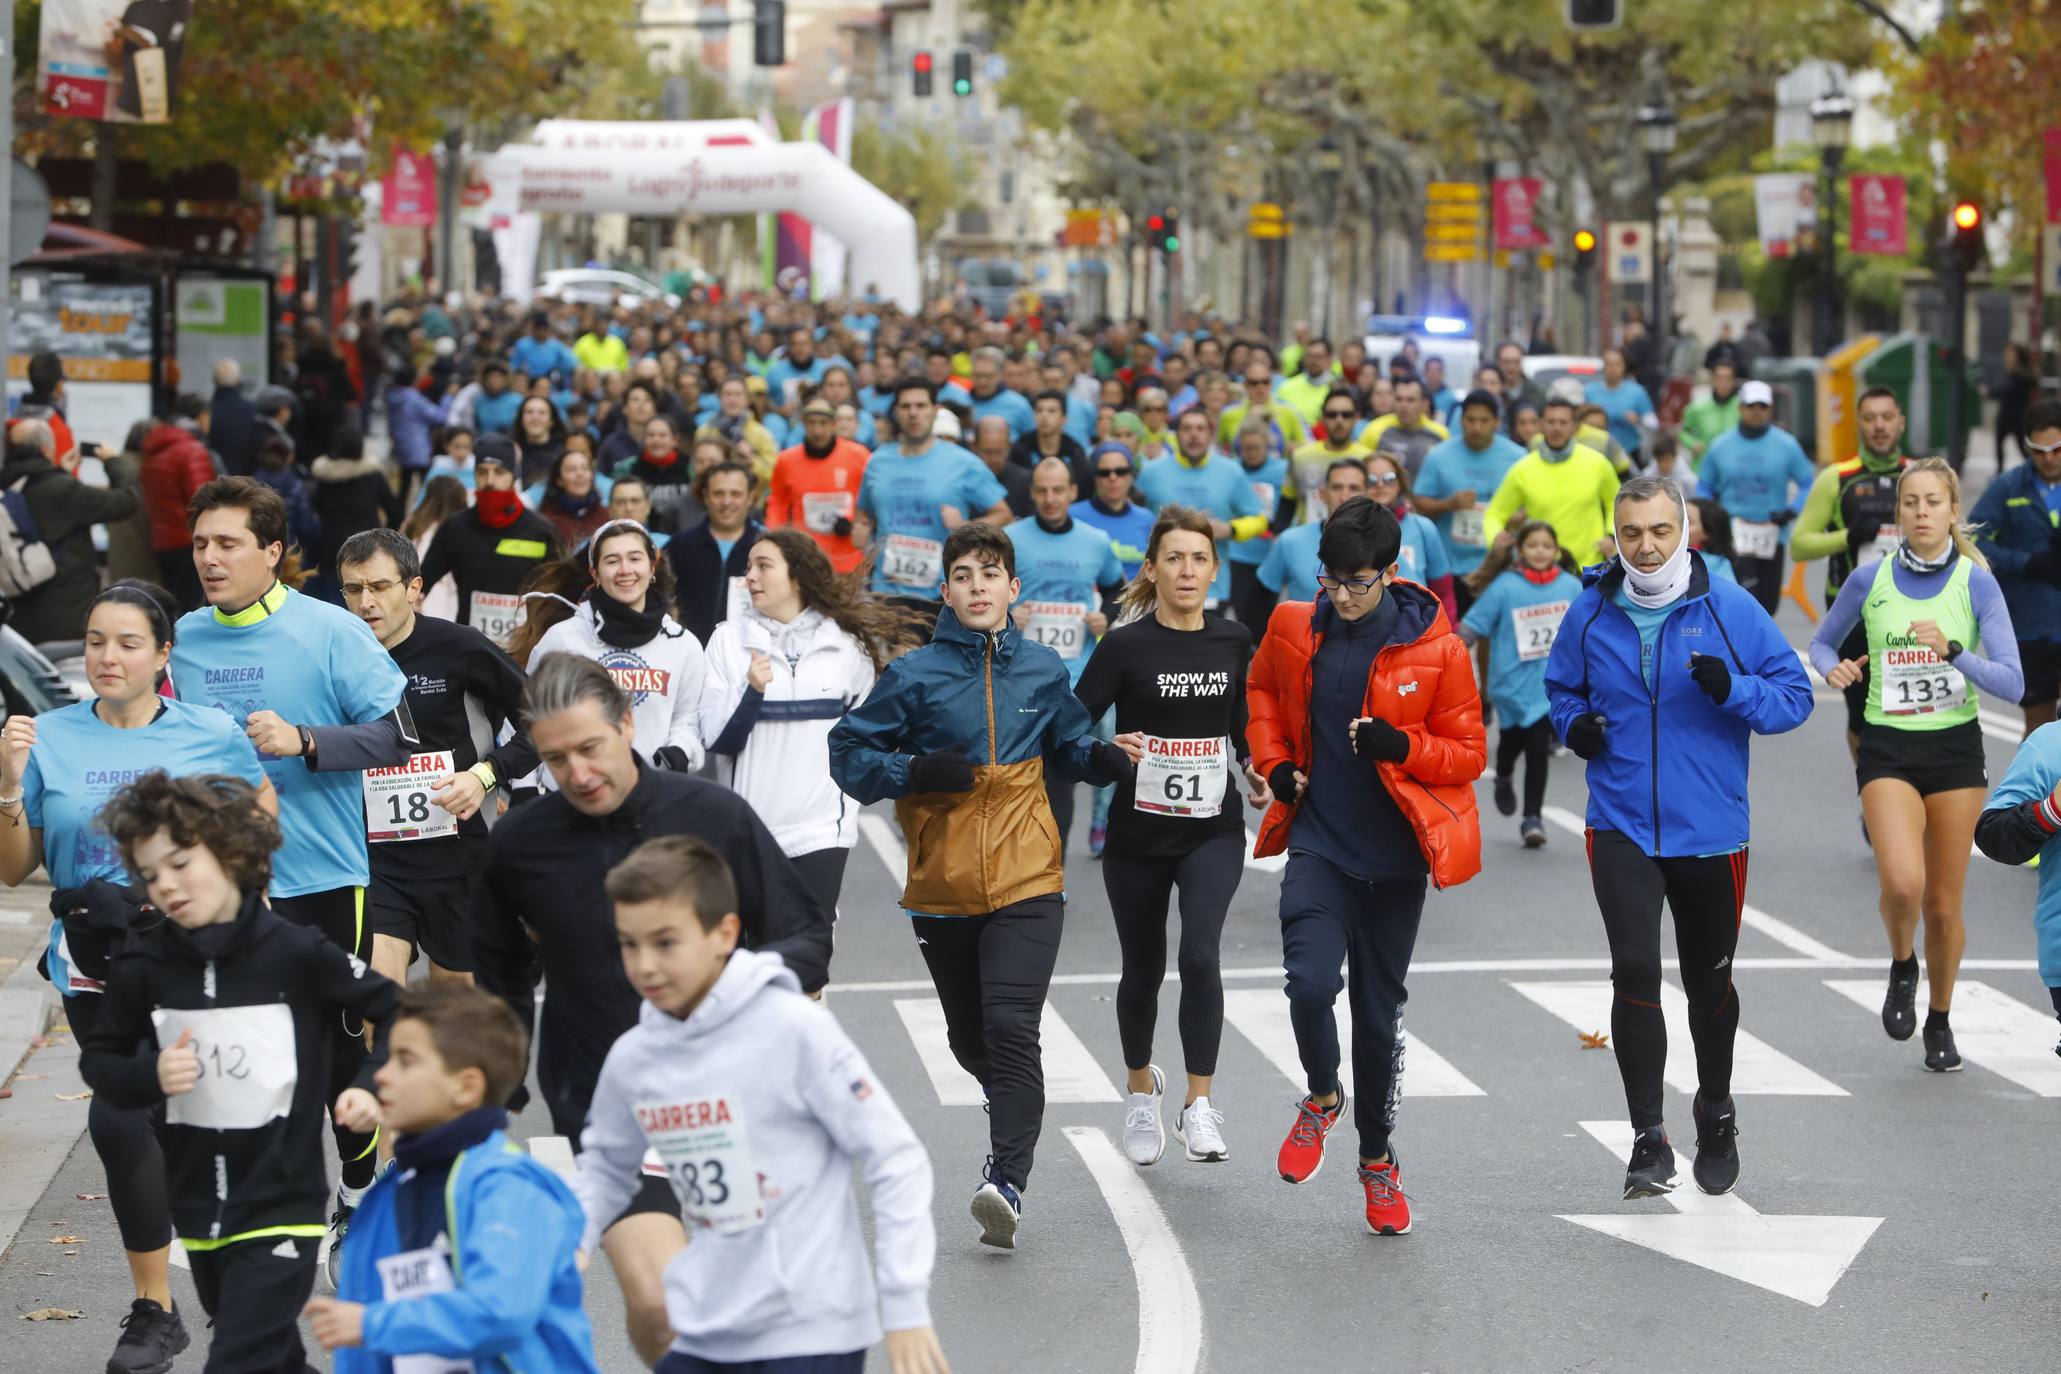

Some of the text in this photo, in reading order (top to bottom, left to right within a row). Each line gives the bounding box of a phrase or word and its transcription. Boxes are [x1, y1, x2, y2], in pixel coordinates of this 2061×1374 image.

[895, 558, 929, 577] 162
[1035, 626, 1075, 646] 120
[205, 667, 264, 684] CARRERA
[1157, 672, 1228, 685] SNOW ME
[1160, 684, 1227, 697] THE WAY
[1898, 676, 1952, 703] 133
[1149, 737, 1221, 757] CARRERA
[1164, 774, 1203, 802] 61
[387, 792, 430, 824] 18
[639, 1098, 732, 1135] CARRERA
